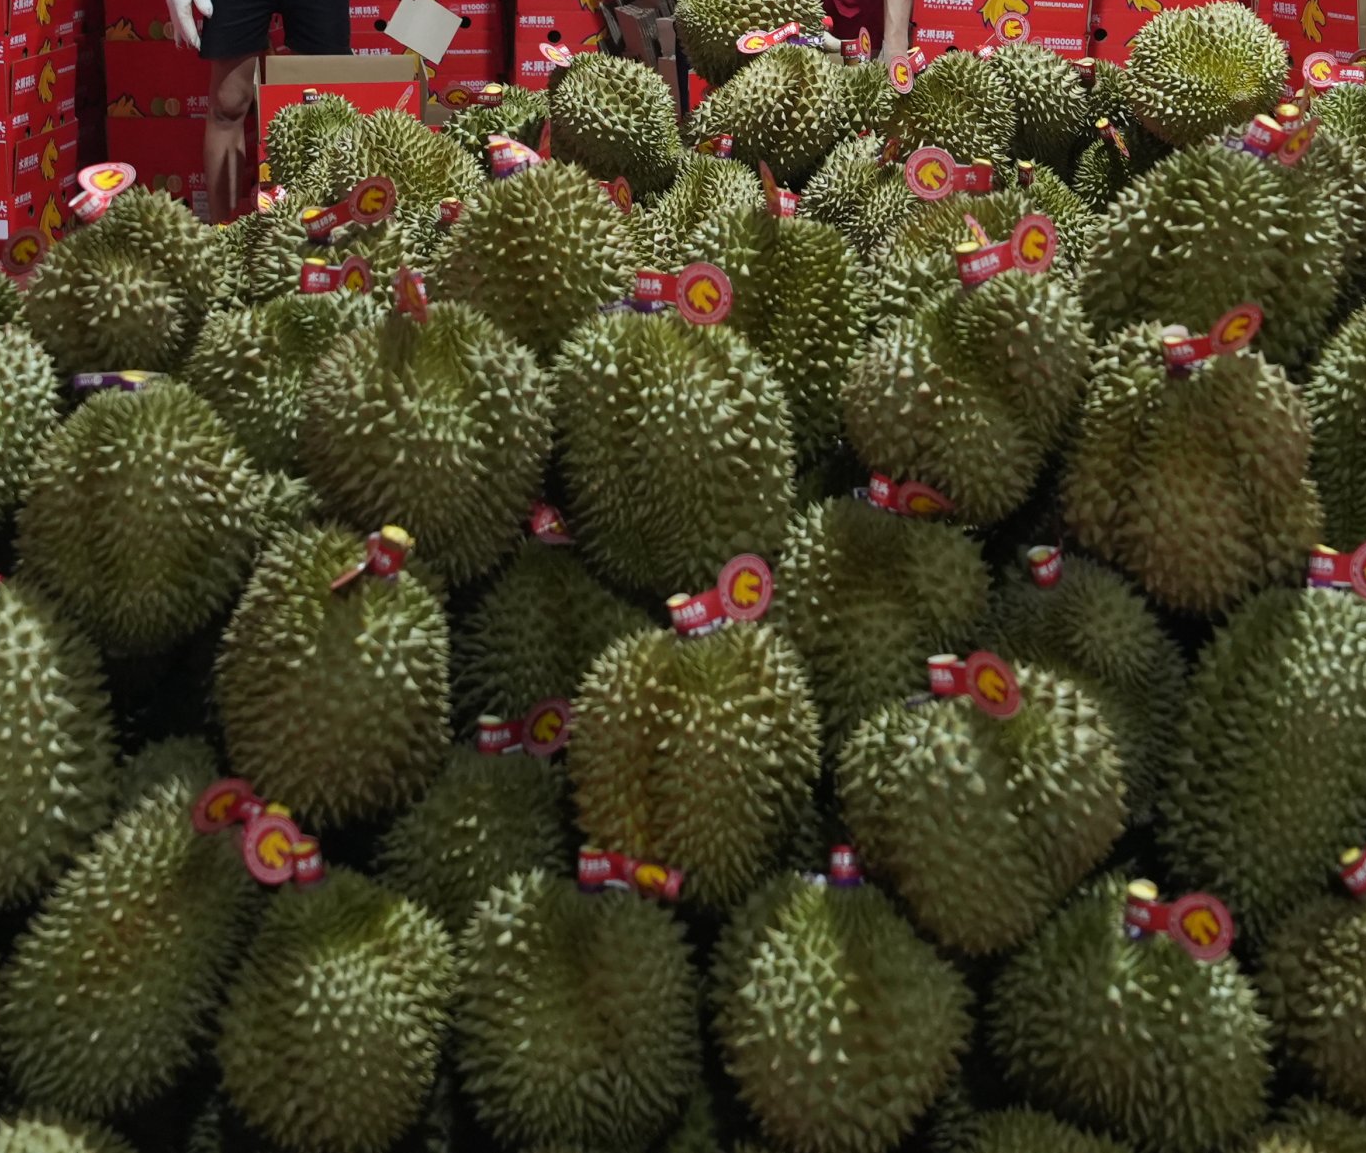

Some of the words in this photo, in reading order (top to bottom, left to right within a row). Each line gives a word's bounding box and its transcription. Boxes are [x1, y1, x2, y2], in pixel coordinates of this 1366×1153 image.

[917, 29, 954, 39] 水果码头
[1339, 69, 1364, 79] 水果码头
